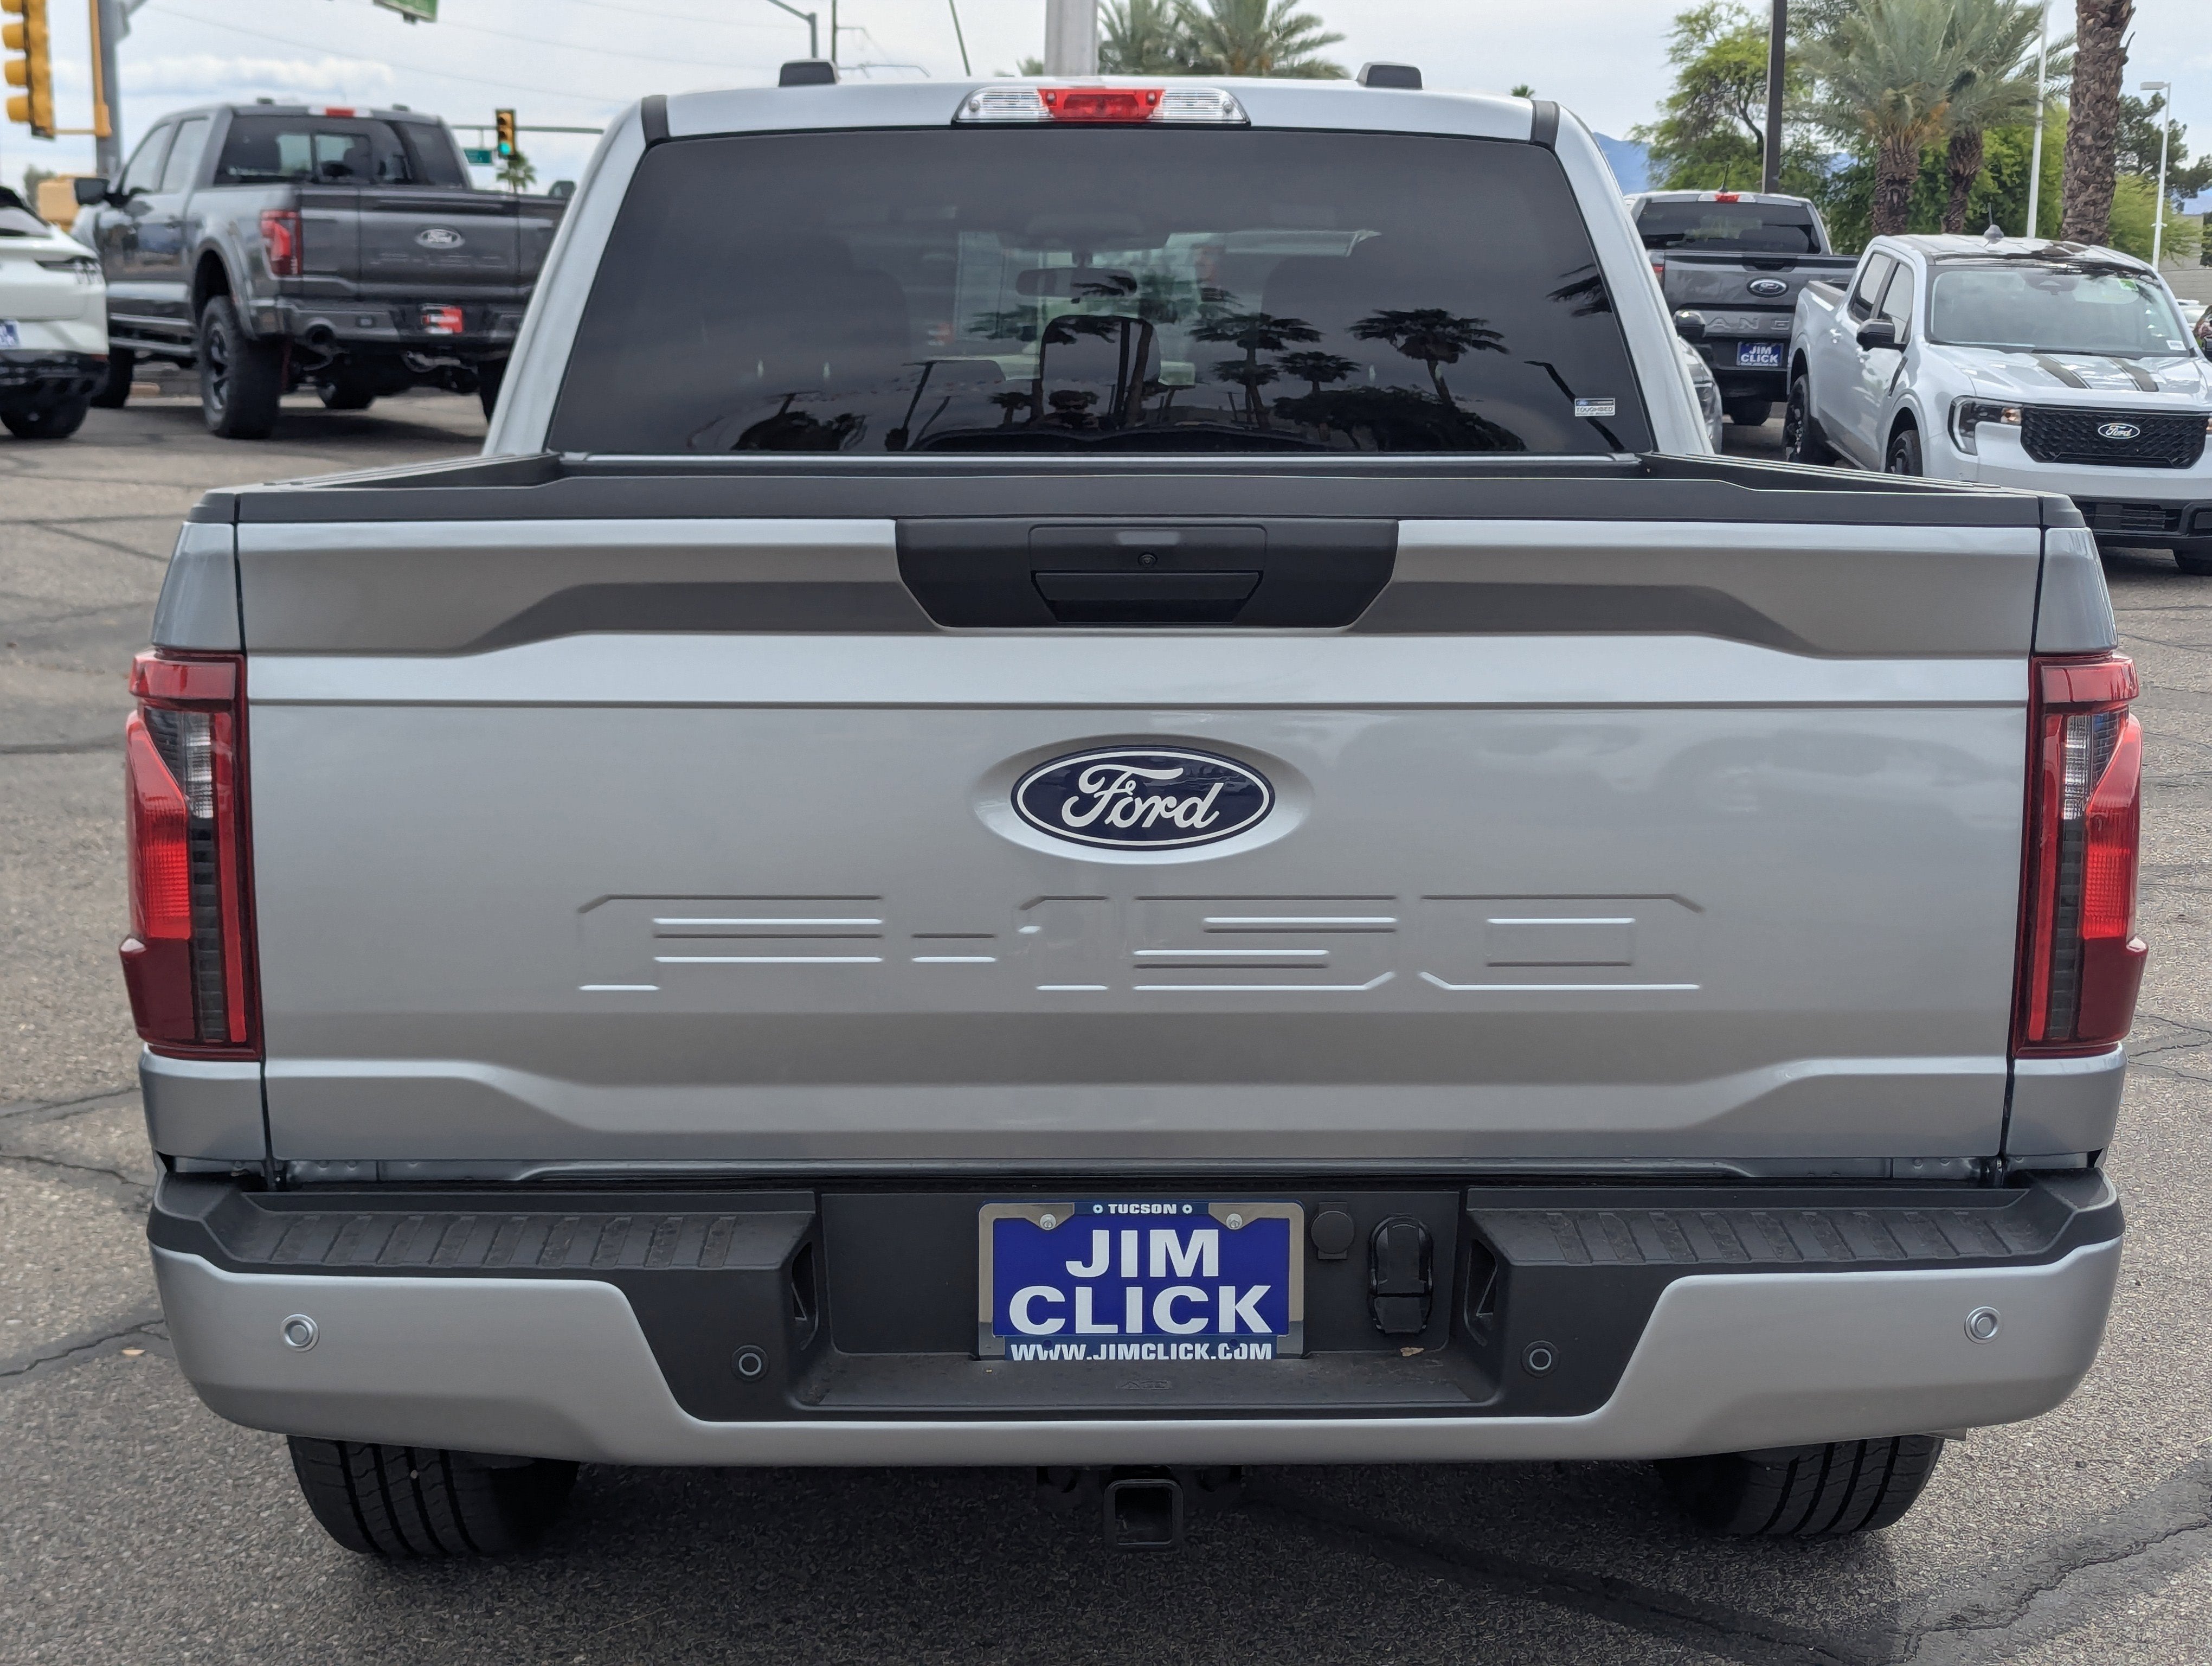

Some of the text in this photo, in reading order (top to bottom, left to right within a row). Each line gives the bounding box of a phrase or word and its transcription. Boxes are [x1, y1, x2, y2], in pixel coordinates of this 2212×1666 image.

[1741, 354, 1778, 363] CLICK
[1749, 345, 1772, 354] JIM
[1061, 764, 1225, 829] Ford
[1108, 1203, 1177, 1215] TUCSON
[1065, 1229, 1219, 1278] JIM
[1008, 1285, 1273, 1335] CLICK
[1010, 1342, 1272, 1361] WWW.JIMCLICK.COM
